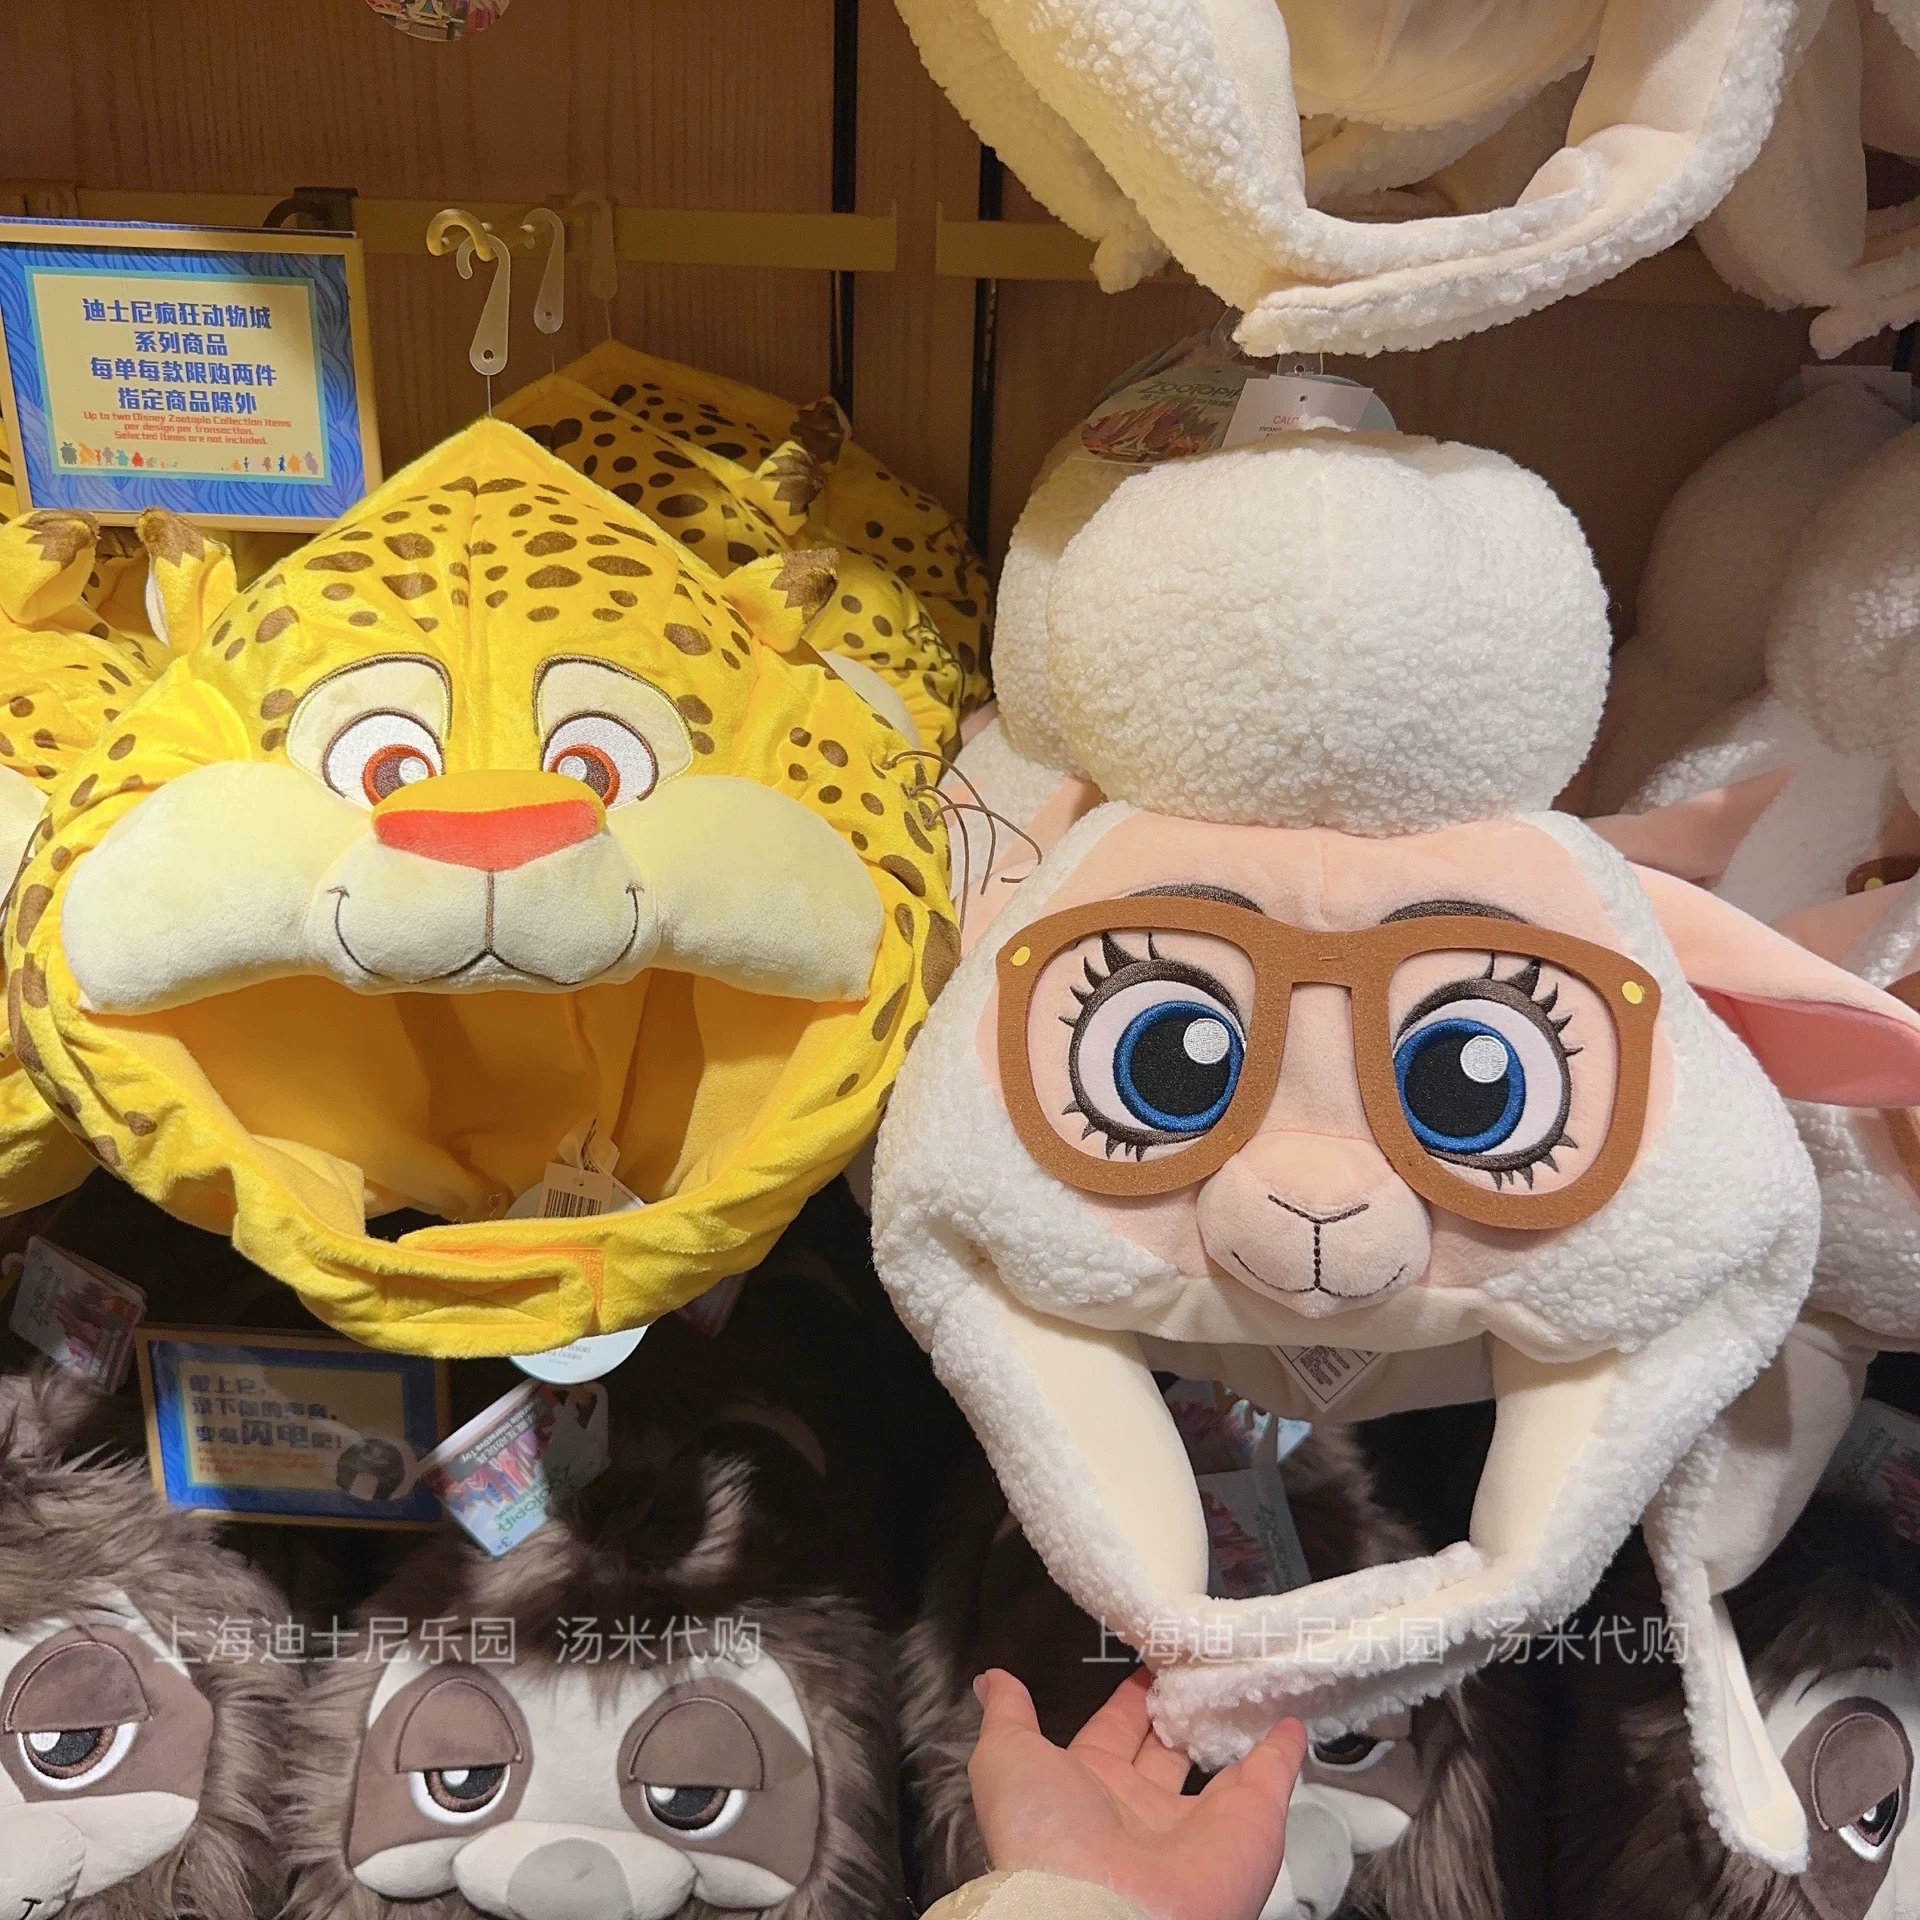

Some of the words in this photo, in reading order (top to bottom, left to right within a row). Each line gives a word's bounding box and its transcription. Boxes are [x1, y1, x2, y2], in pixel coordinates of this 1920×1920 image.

[82, 298, 271, 329] 迪士尼疯狂动物城
[135, 331, 228, 356] 系列商品
[90, 357, 277, 387] 每单每款限购两件
[118, 387, 257, 414] 指定商品除外
[84, 411, 97, 420] Up
[100, 412, 109, 420] to
[112, 412, 130, 420] two
[133, 412, 166, 423] Disney
[169, 414, 211, 425] Zootopia
[213, 416, 262, 426] Collection
[124, 423, 140, 431] per
[142, 422, 174, 433] design
[177, 426, 192, 434] per
[195, 426, 254, 435] transaction.
[114, 431, 158, 440] Selected
[160, 432, 186, 441] items
[225, 436, 268, 445] included.
